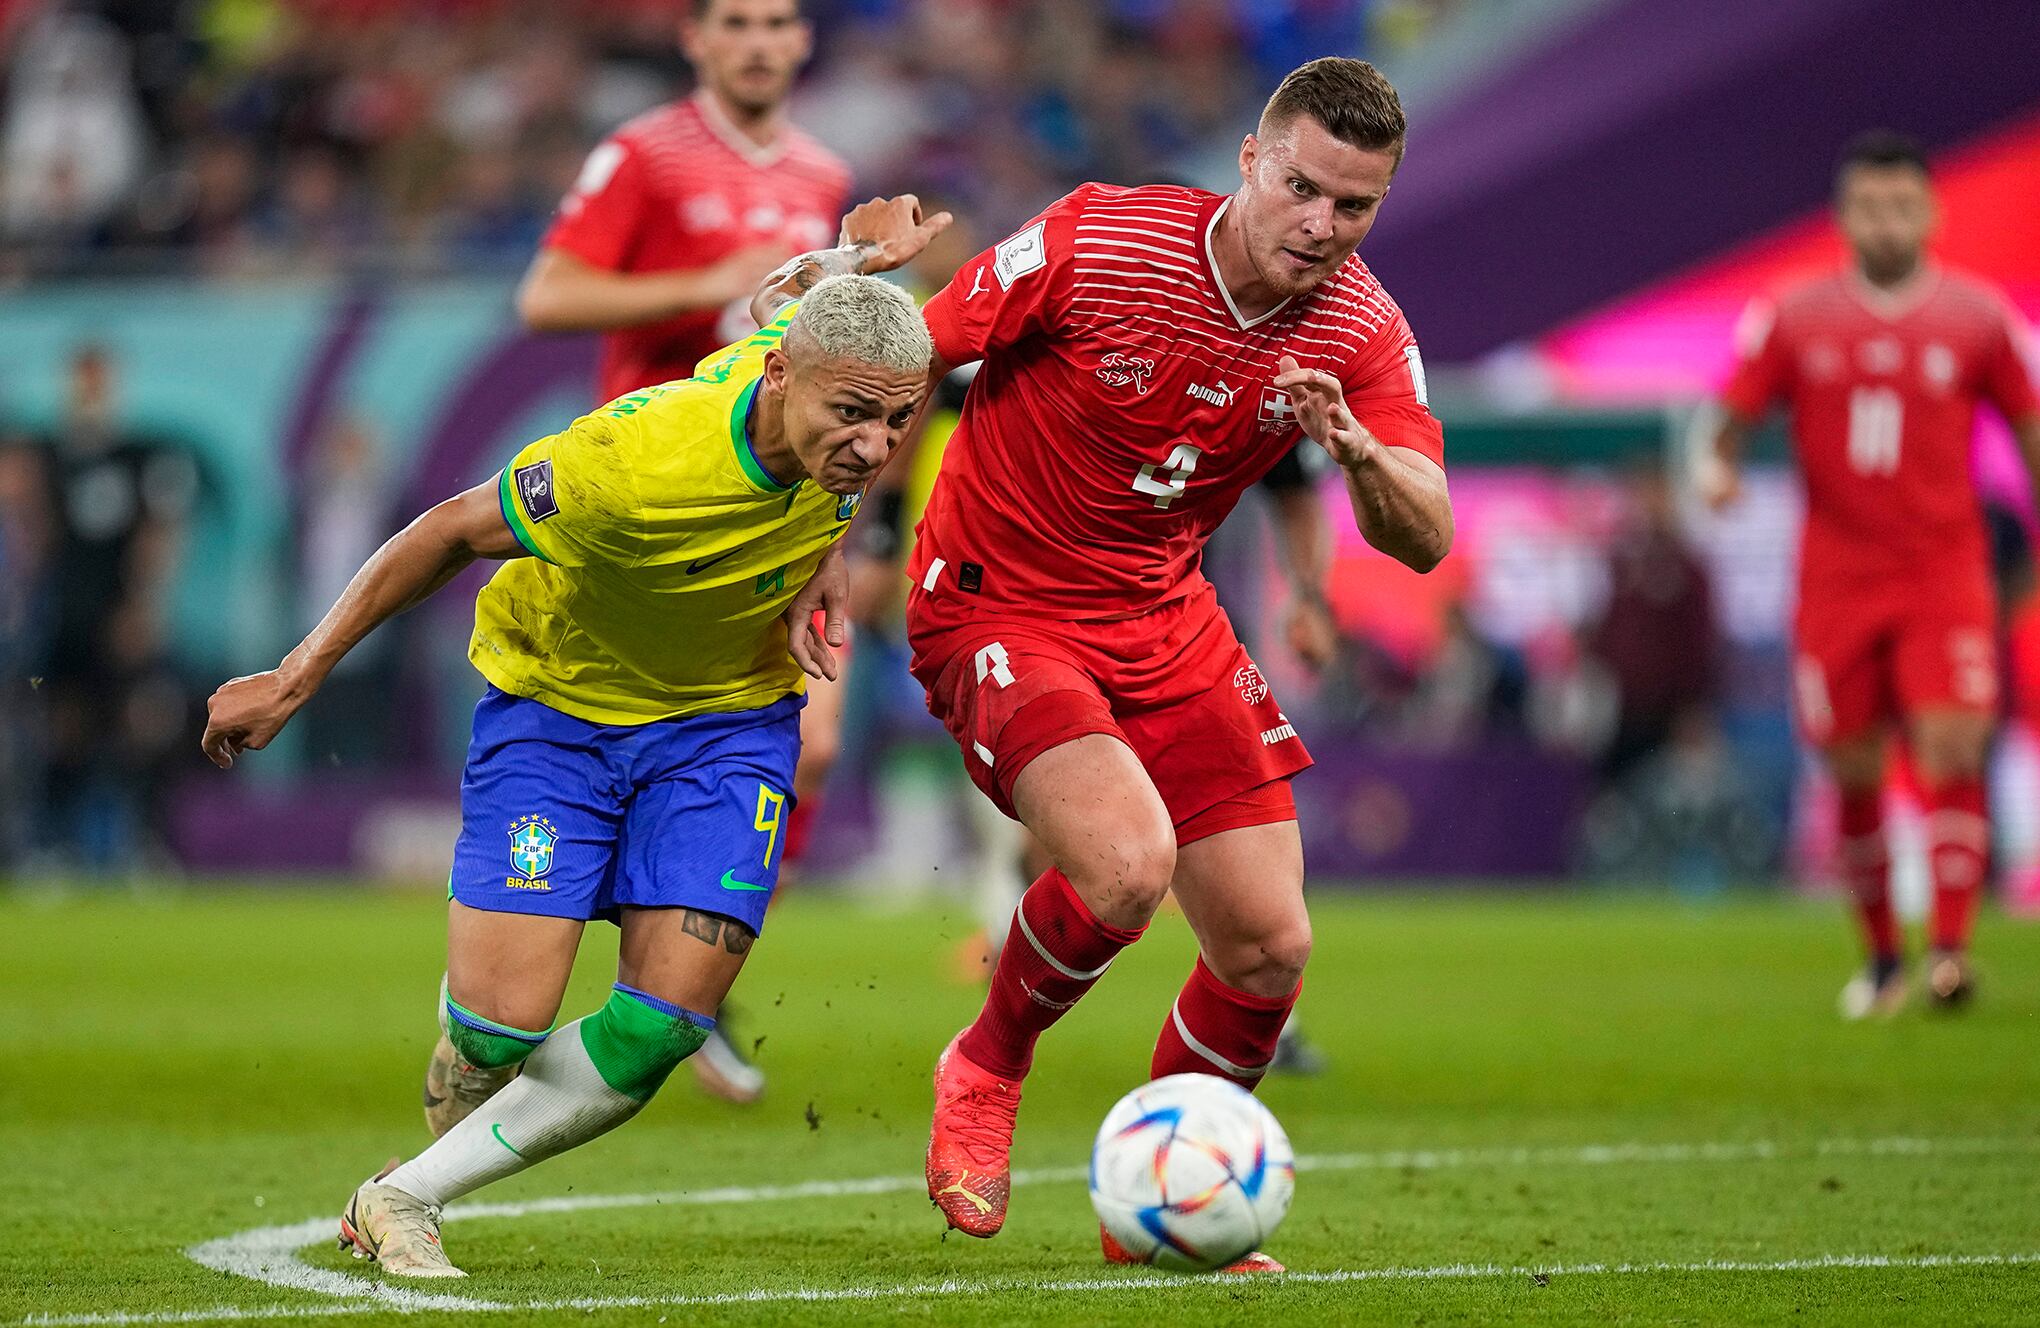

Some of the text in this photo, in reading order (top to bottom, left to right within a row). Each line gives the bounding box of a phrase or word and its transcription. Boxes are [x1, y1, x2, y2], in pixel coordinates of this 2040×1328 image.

[1186, 382, 1227, 407] PUMA
[1131, 443, 1202, 509] 4
[754, 782, 785, 871] 9
[523, 845, 542, 854] CBF
[506, 877, 552, 891] BRASIL
